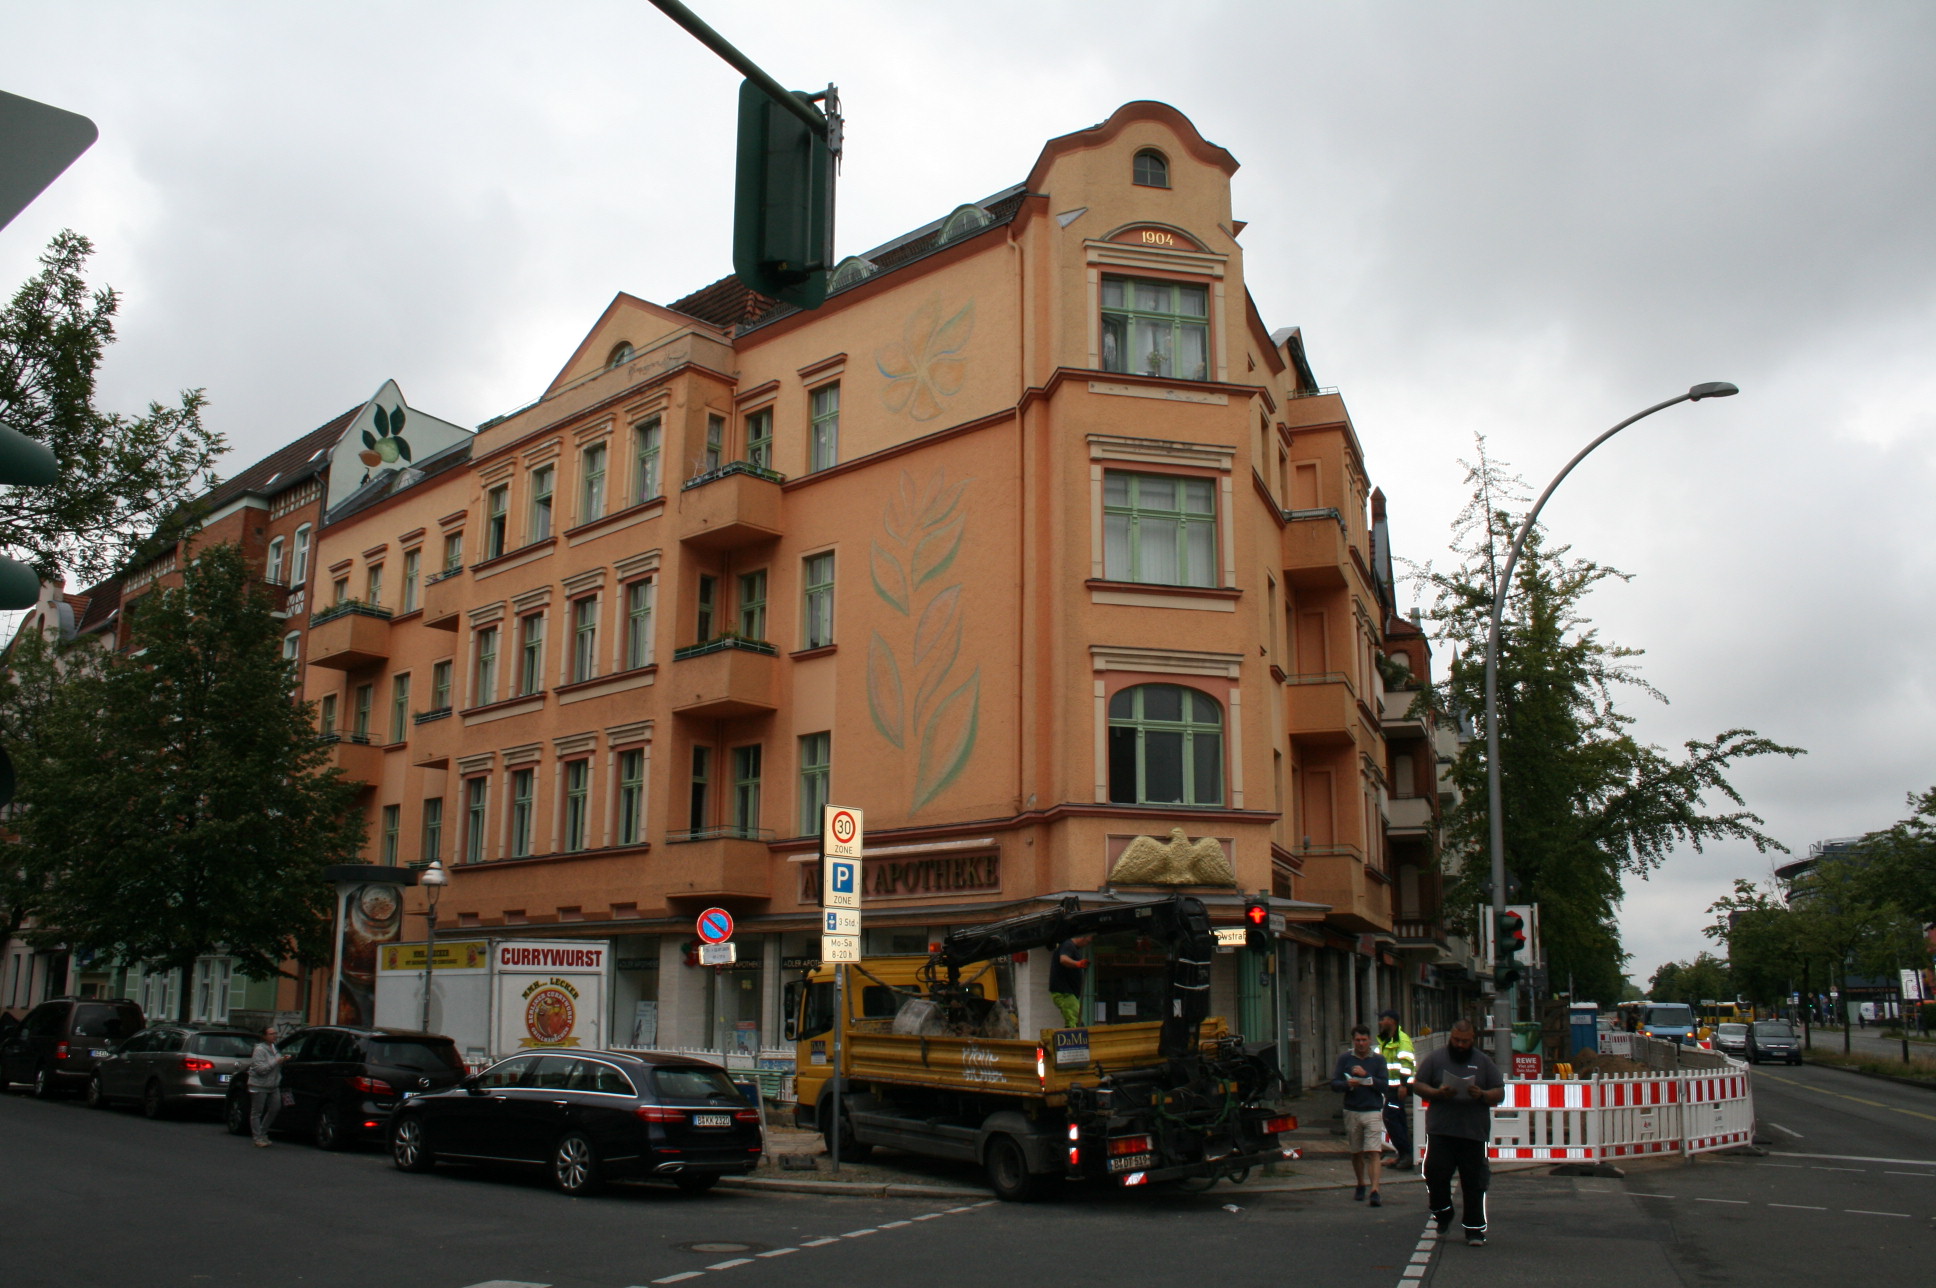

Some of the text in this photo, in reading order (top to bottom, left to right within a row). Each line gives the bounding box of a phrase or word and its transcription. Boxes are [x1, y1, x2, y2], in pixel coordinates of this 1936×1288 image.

[1142, 231, 1174, 246] 1904
[837, 819, 851, 835] 30
[834, 845, 853, 855] ZONE
[837, 866, 849, 889] P
[875, 855, 999, 894] APOTHEKE
[833, 896, 852, 905] ZONE
[838, 918, 857, 927] 3 Std.
[831, 938, 853, 947] Mo-Sa
[501, 947, 602, 967] CURRYWURST
[832, 950, 853, 959] 8-20 h
[783, 960, 802, 968] ADLER
[550, 977, 579, 1000] LECKER
